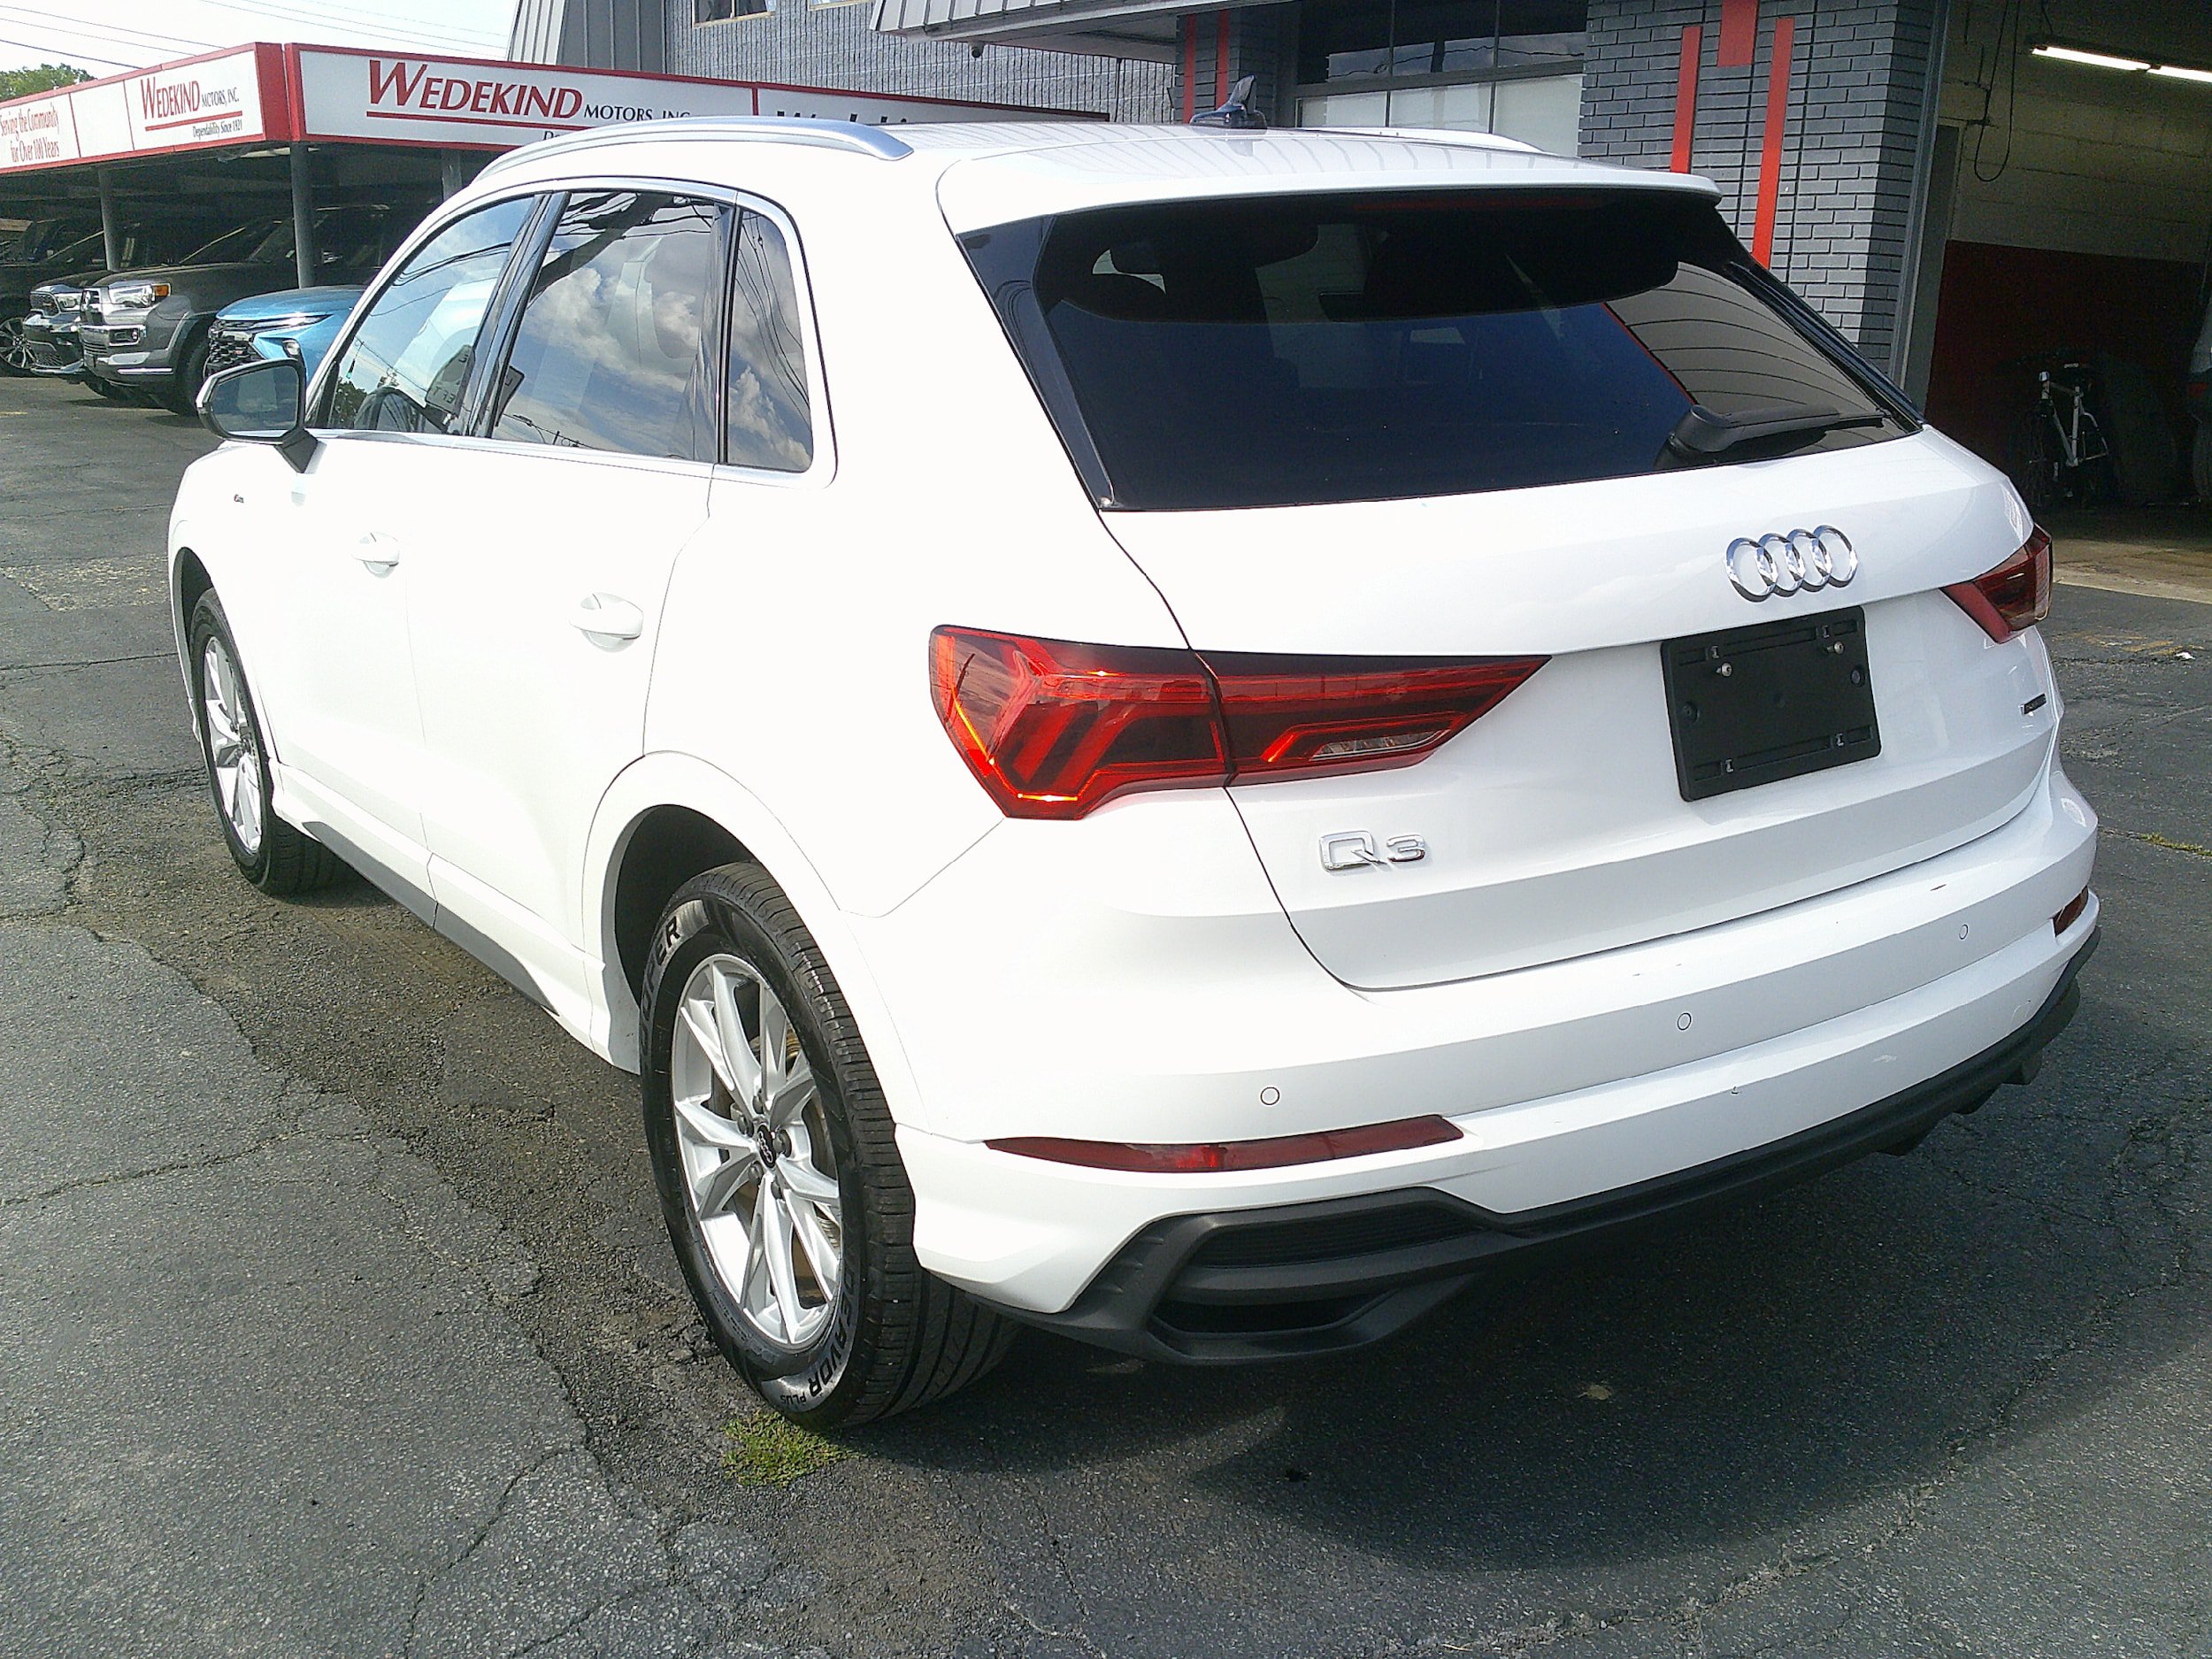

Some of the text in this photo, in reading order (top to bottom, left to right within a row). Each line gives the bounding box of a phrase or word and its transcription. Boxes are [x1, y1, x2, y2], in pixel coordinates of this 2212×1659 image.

[141, 76, 201, 119] WEDEKIND
[369, 59, 583, 119] WEDEKIND
[19, 108, 30, 134] the
[27, 102, 60, 134] Community
[19, 140, 34, 162] Over
[33, 138, 43, 160] 100
[42, 136, 60, 158] Years
[1319, 830, 1426, 872] Q3
[780, 1390, 807, 1406] PLUS
